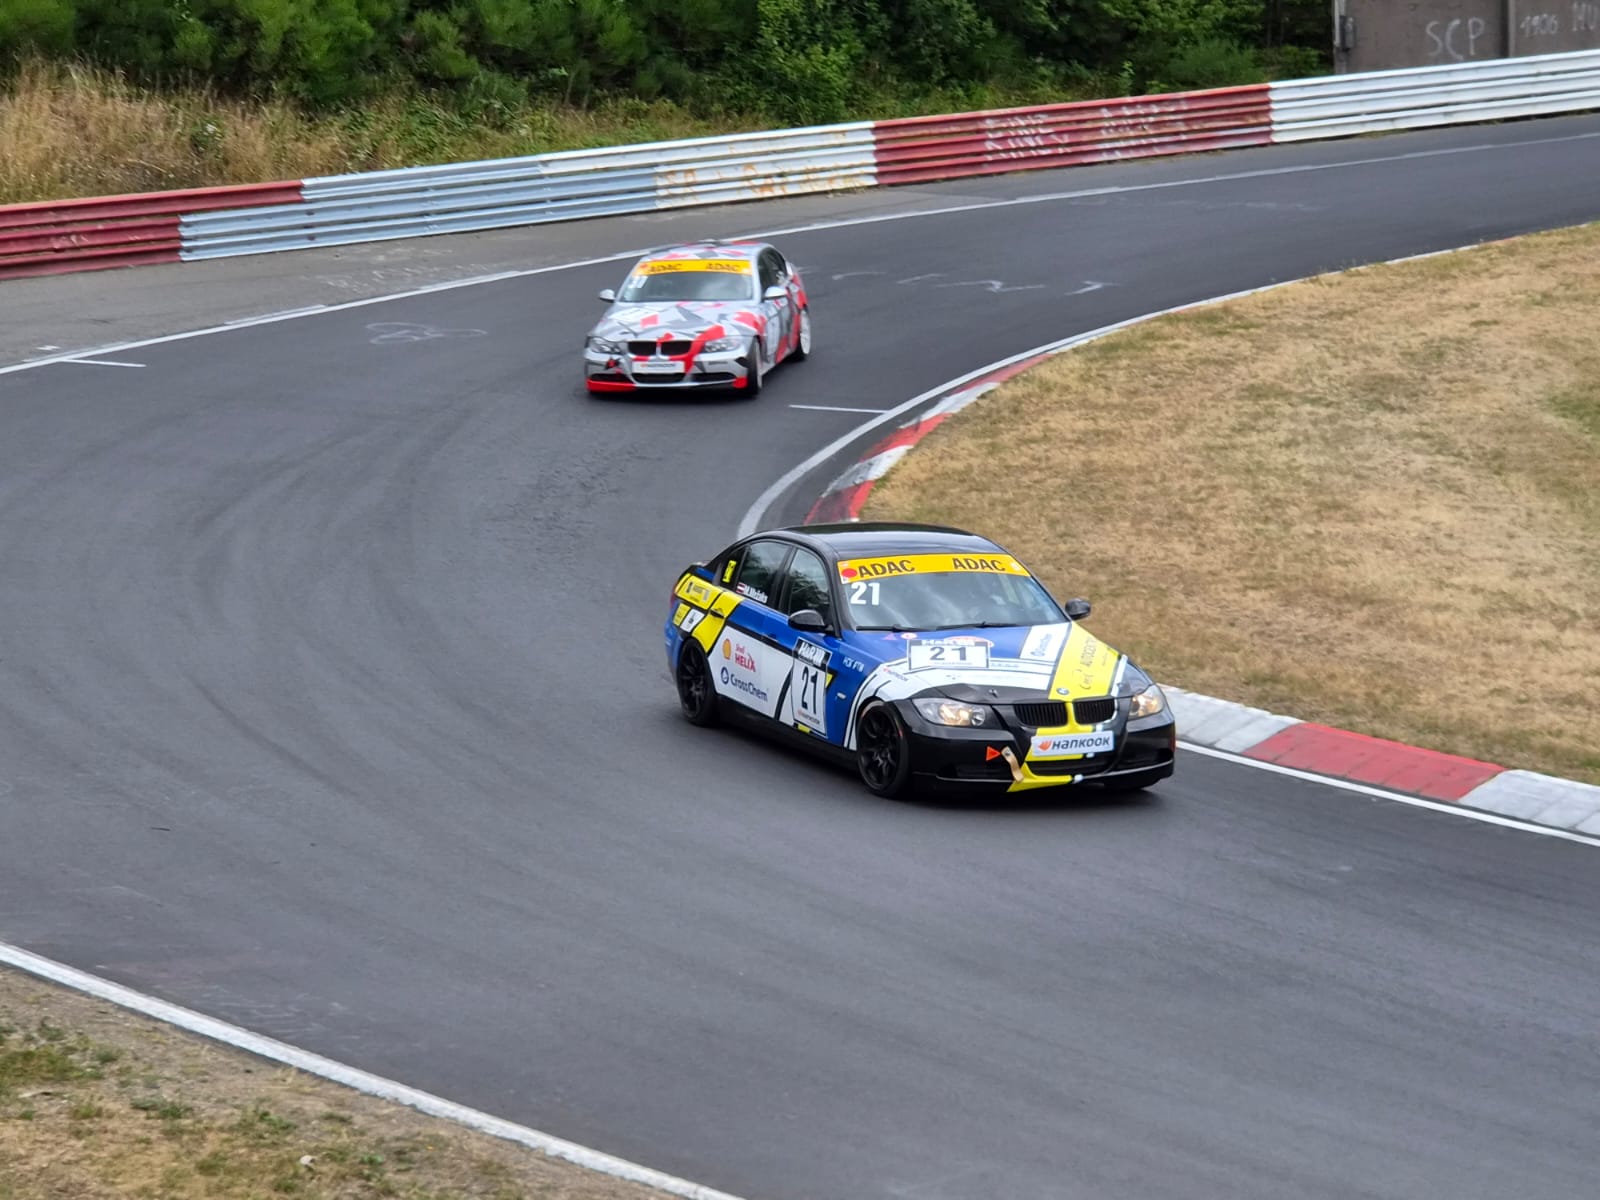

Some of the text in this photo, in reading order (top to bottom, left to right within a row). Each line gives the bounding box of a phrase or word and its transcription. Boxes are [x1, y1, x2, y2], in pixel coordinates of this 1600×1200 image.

[1425, 17, 1485, 60] SCP
[858, 557, 1006, 578] ADAC ADAC
[850, 581, 881, 606] 21
[734, 653, 756, 673] HELIX
[929, 646, 967, 661] 21
[730, 673, 768, 702] CrossChem
[801, 665, 819, 715] 21
